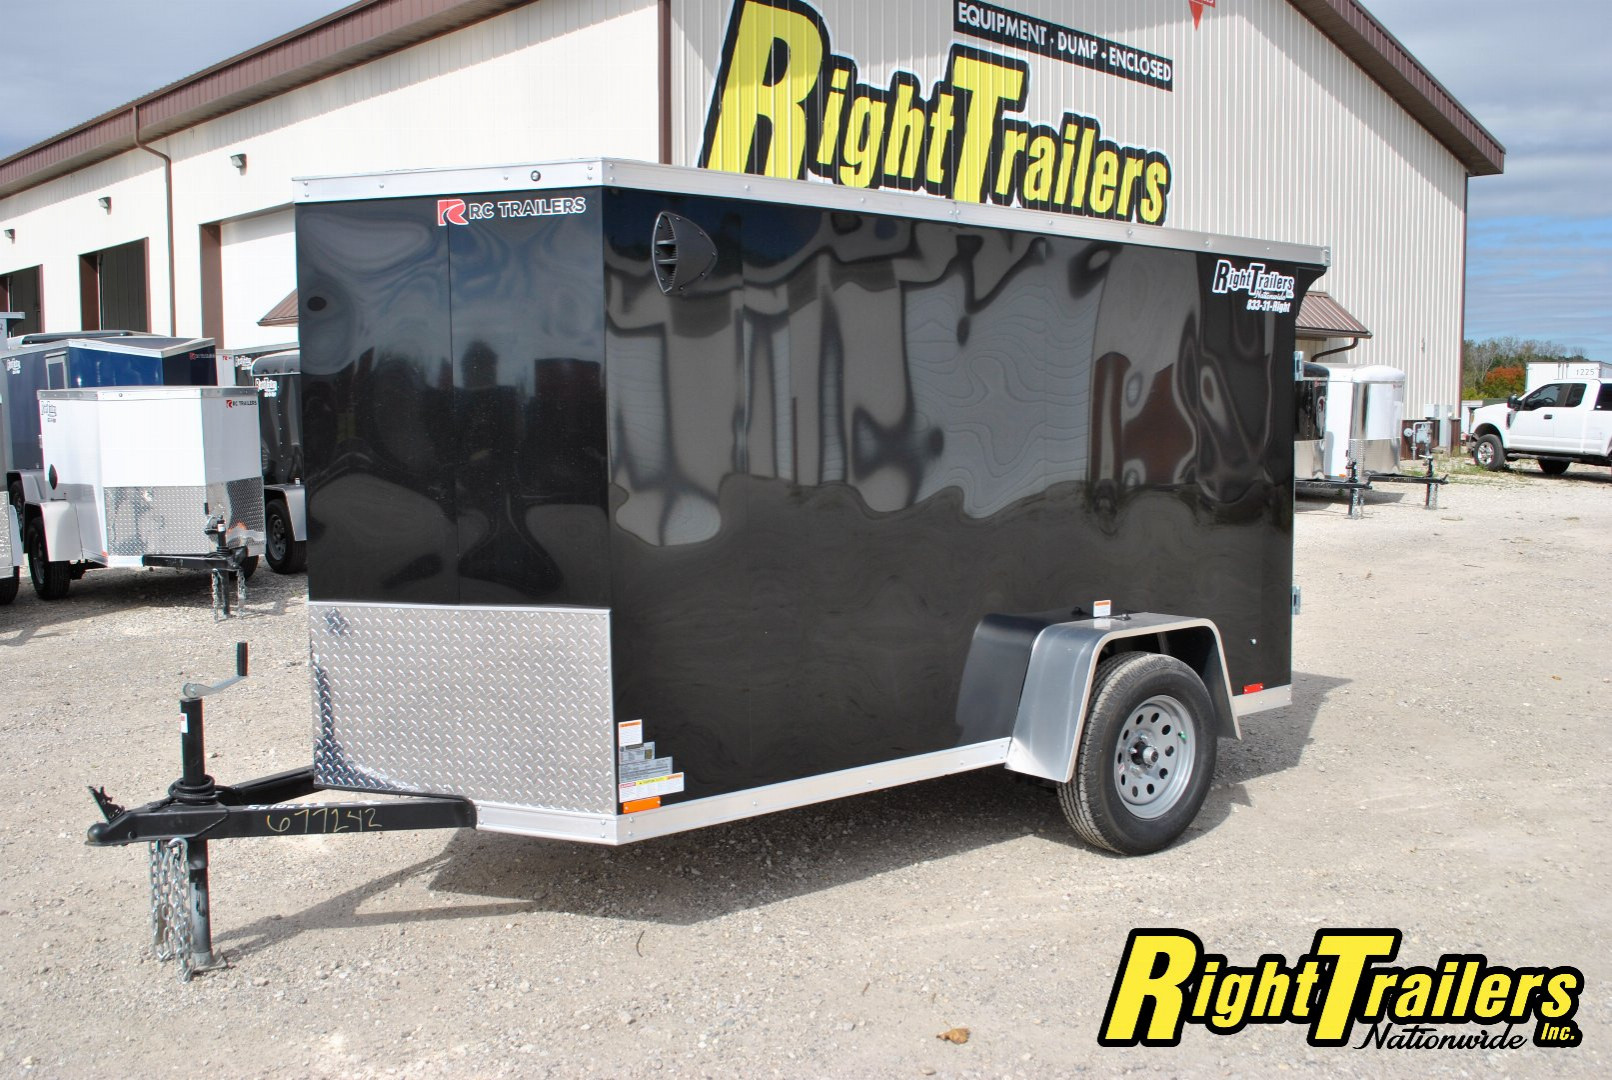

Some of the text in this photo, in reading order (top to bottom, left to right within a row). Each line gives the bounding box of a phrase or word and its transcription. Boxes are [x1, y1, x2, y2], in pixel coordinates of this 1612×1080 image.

[957, 1, 1172, 82] EQUIPMENT DUMP ENCLOSED
[468, 202, 495, 220] RC
[498, 197, 586, 217] TRAILERS
[266, 807, 382, 833] 677242
